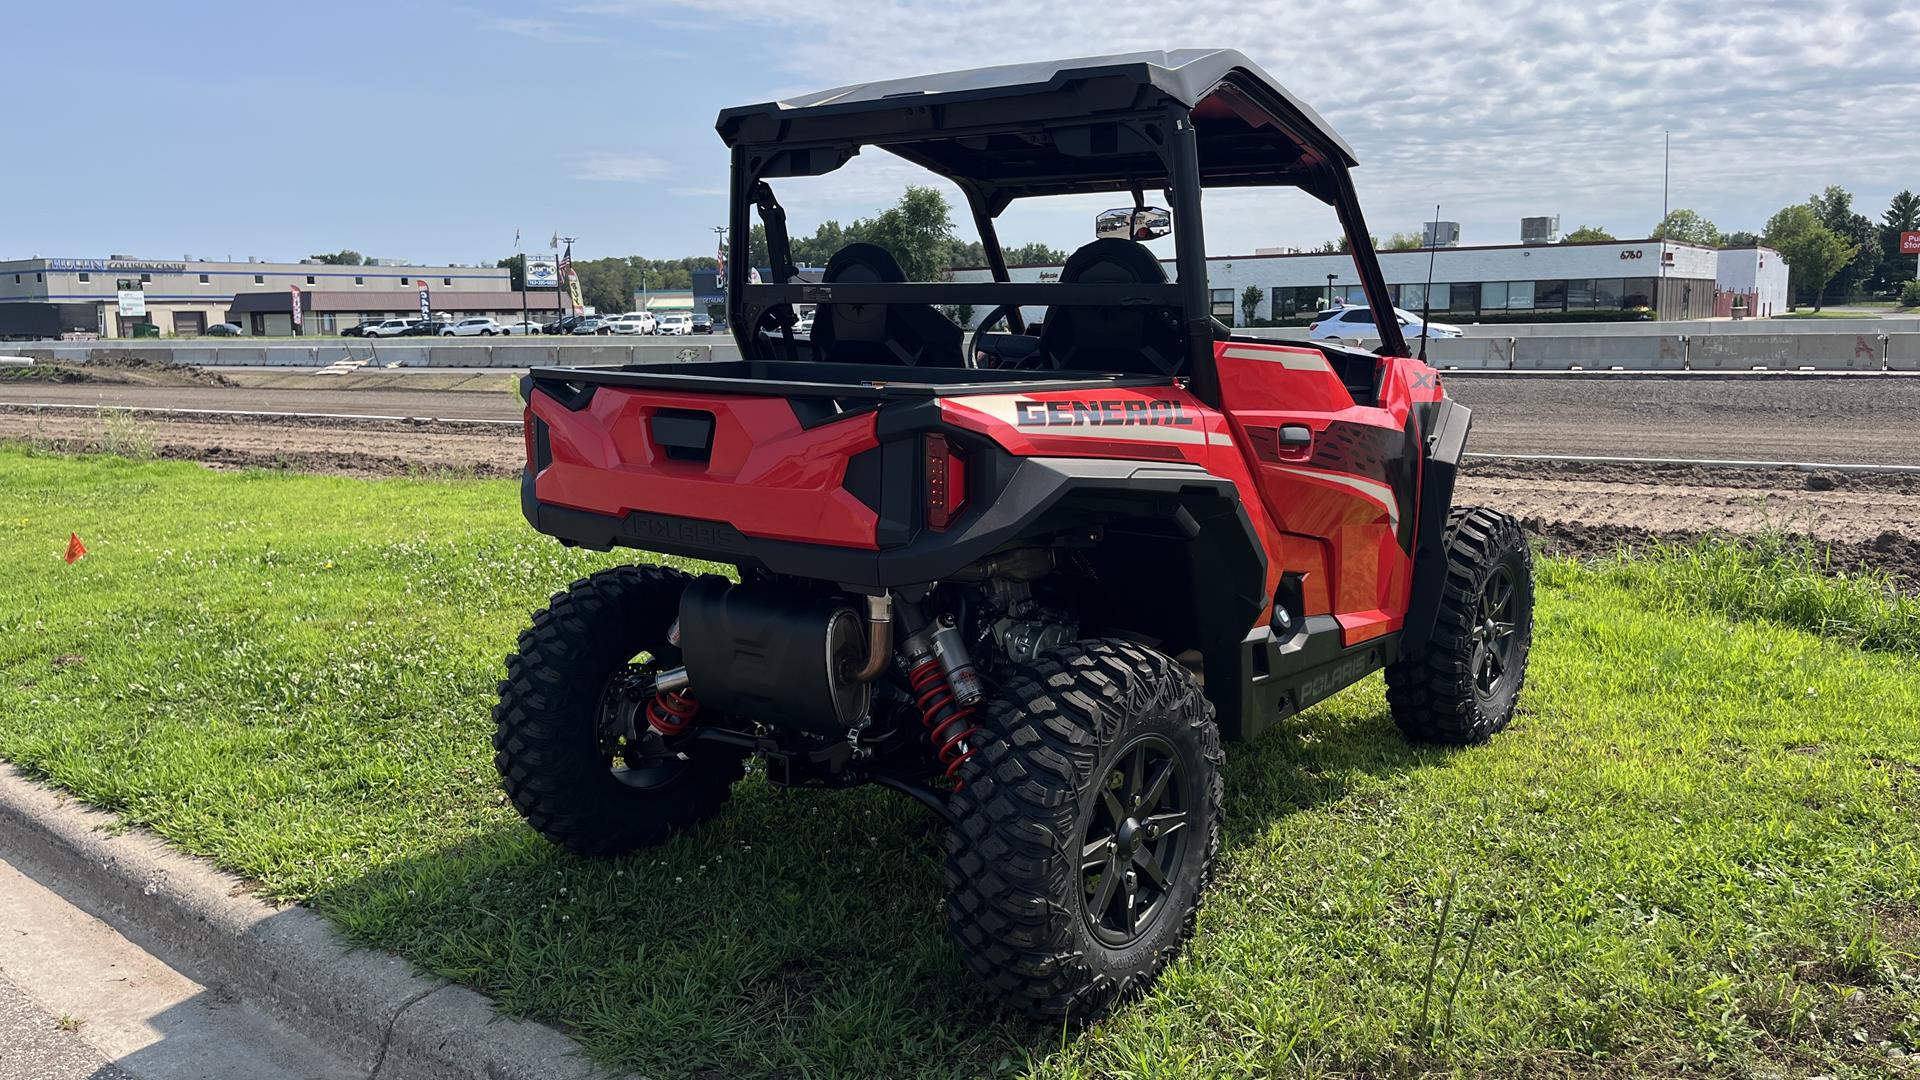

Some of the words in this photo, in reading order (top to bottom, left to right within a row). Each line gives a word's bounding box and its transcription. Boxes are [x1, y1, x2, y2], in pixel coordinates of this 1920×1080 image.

[1620, 250, 1643, 260] 6760
[1015, 399, 1193, 427] GENERAL
[633, 514, 733, 545] POLARIS
[1301, 657, 1365, 702] POLARIS
